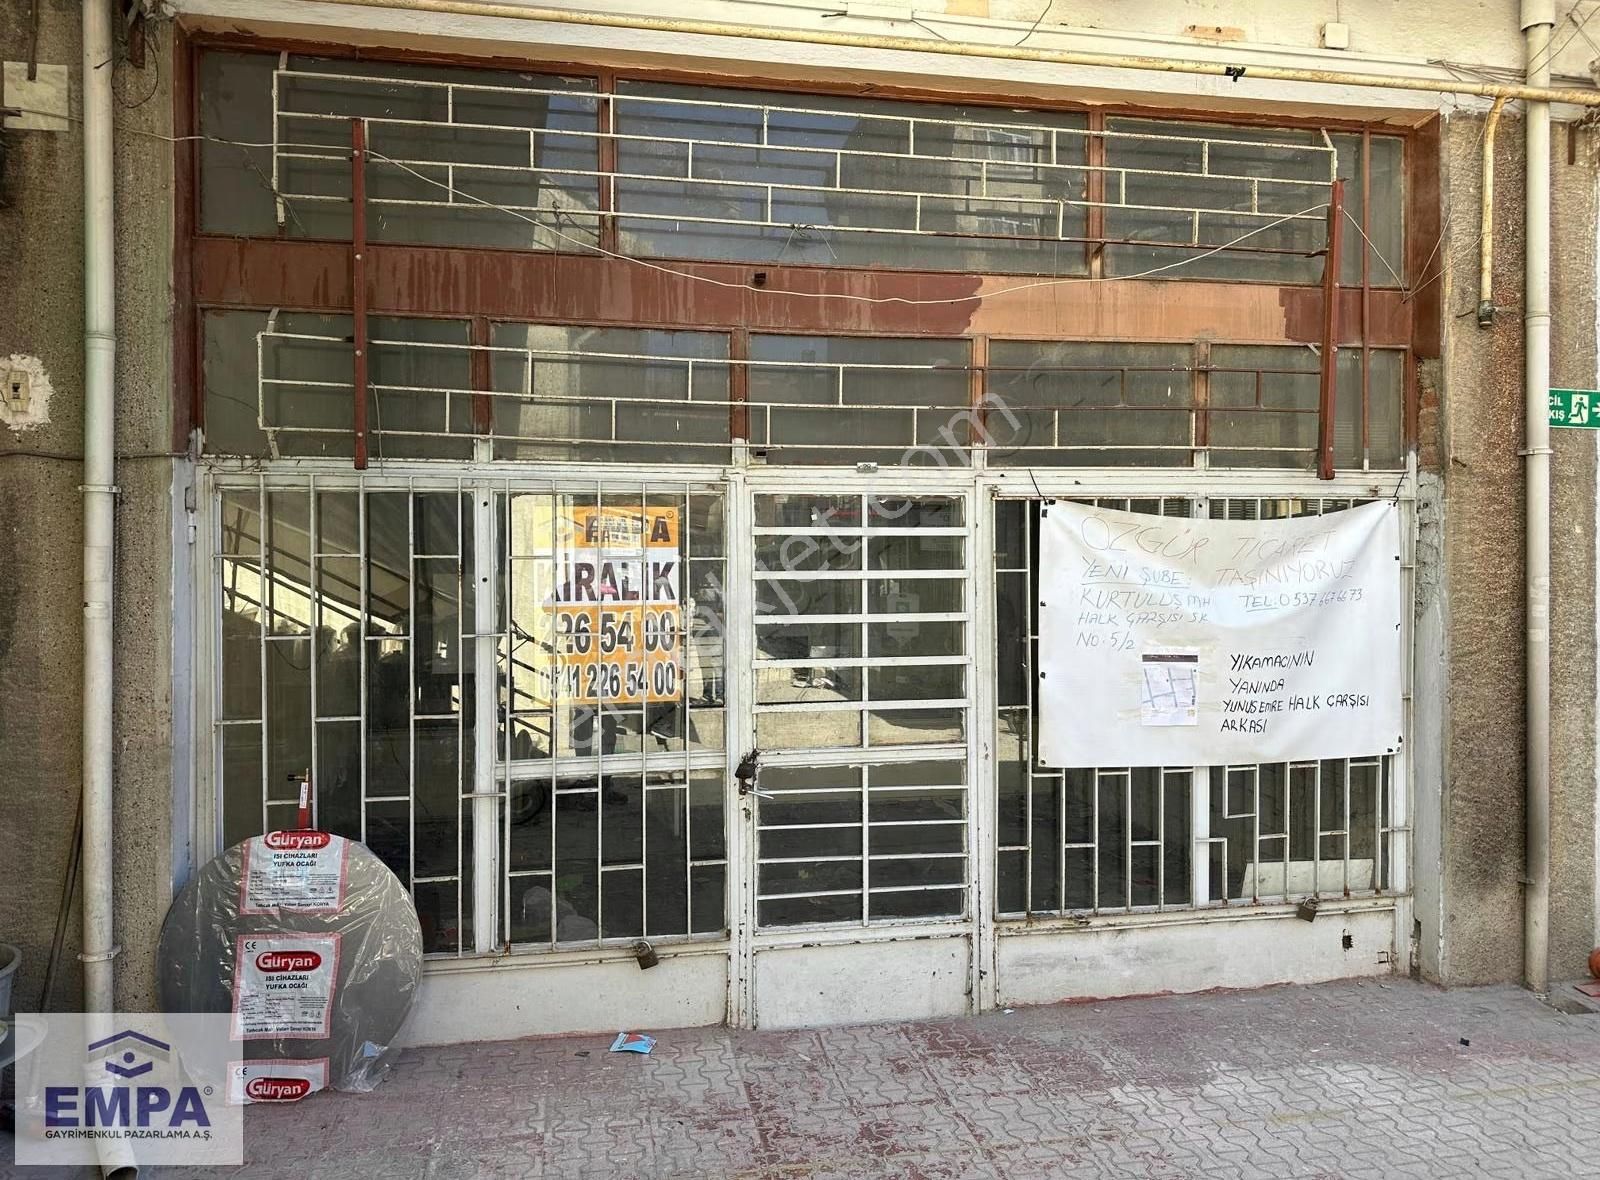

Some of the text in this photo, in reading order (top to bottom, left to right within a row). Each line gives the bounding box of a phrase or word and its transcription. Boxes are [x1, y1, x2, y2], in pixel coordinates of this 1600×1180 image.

[1078, 612, 1120, 626] HALK
[600, 612, 634, 653] 54
[645, 610, 677, 652] 00
[1110, 631, 1136, 651] 5/2
[1230, 650, 1315, 672] YIKAMACININ
[586, 663, 621, 698] 226
[626, 662, 649, 696] 54
[654, 660, 677, 696] 00
[1229, 678, 1285, 695] YANINDA
[1288, 694, 1320, 711] HALK
[1220, 718, 1268, 733] ARKASI
[258, 952, 313, 971] Güryan
[249, 1078, 302, 1099] Güryan
